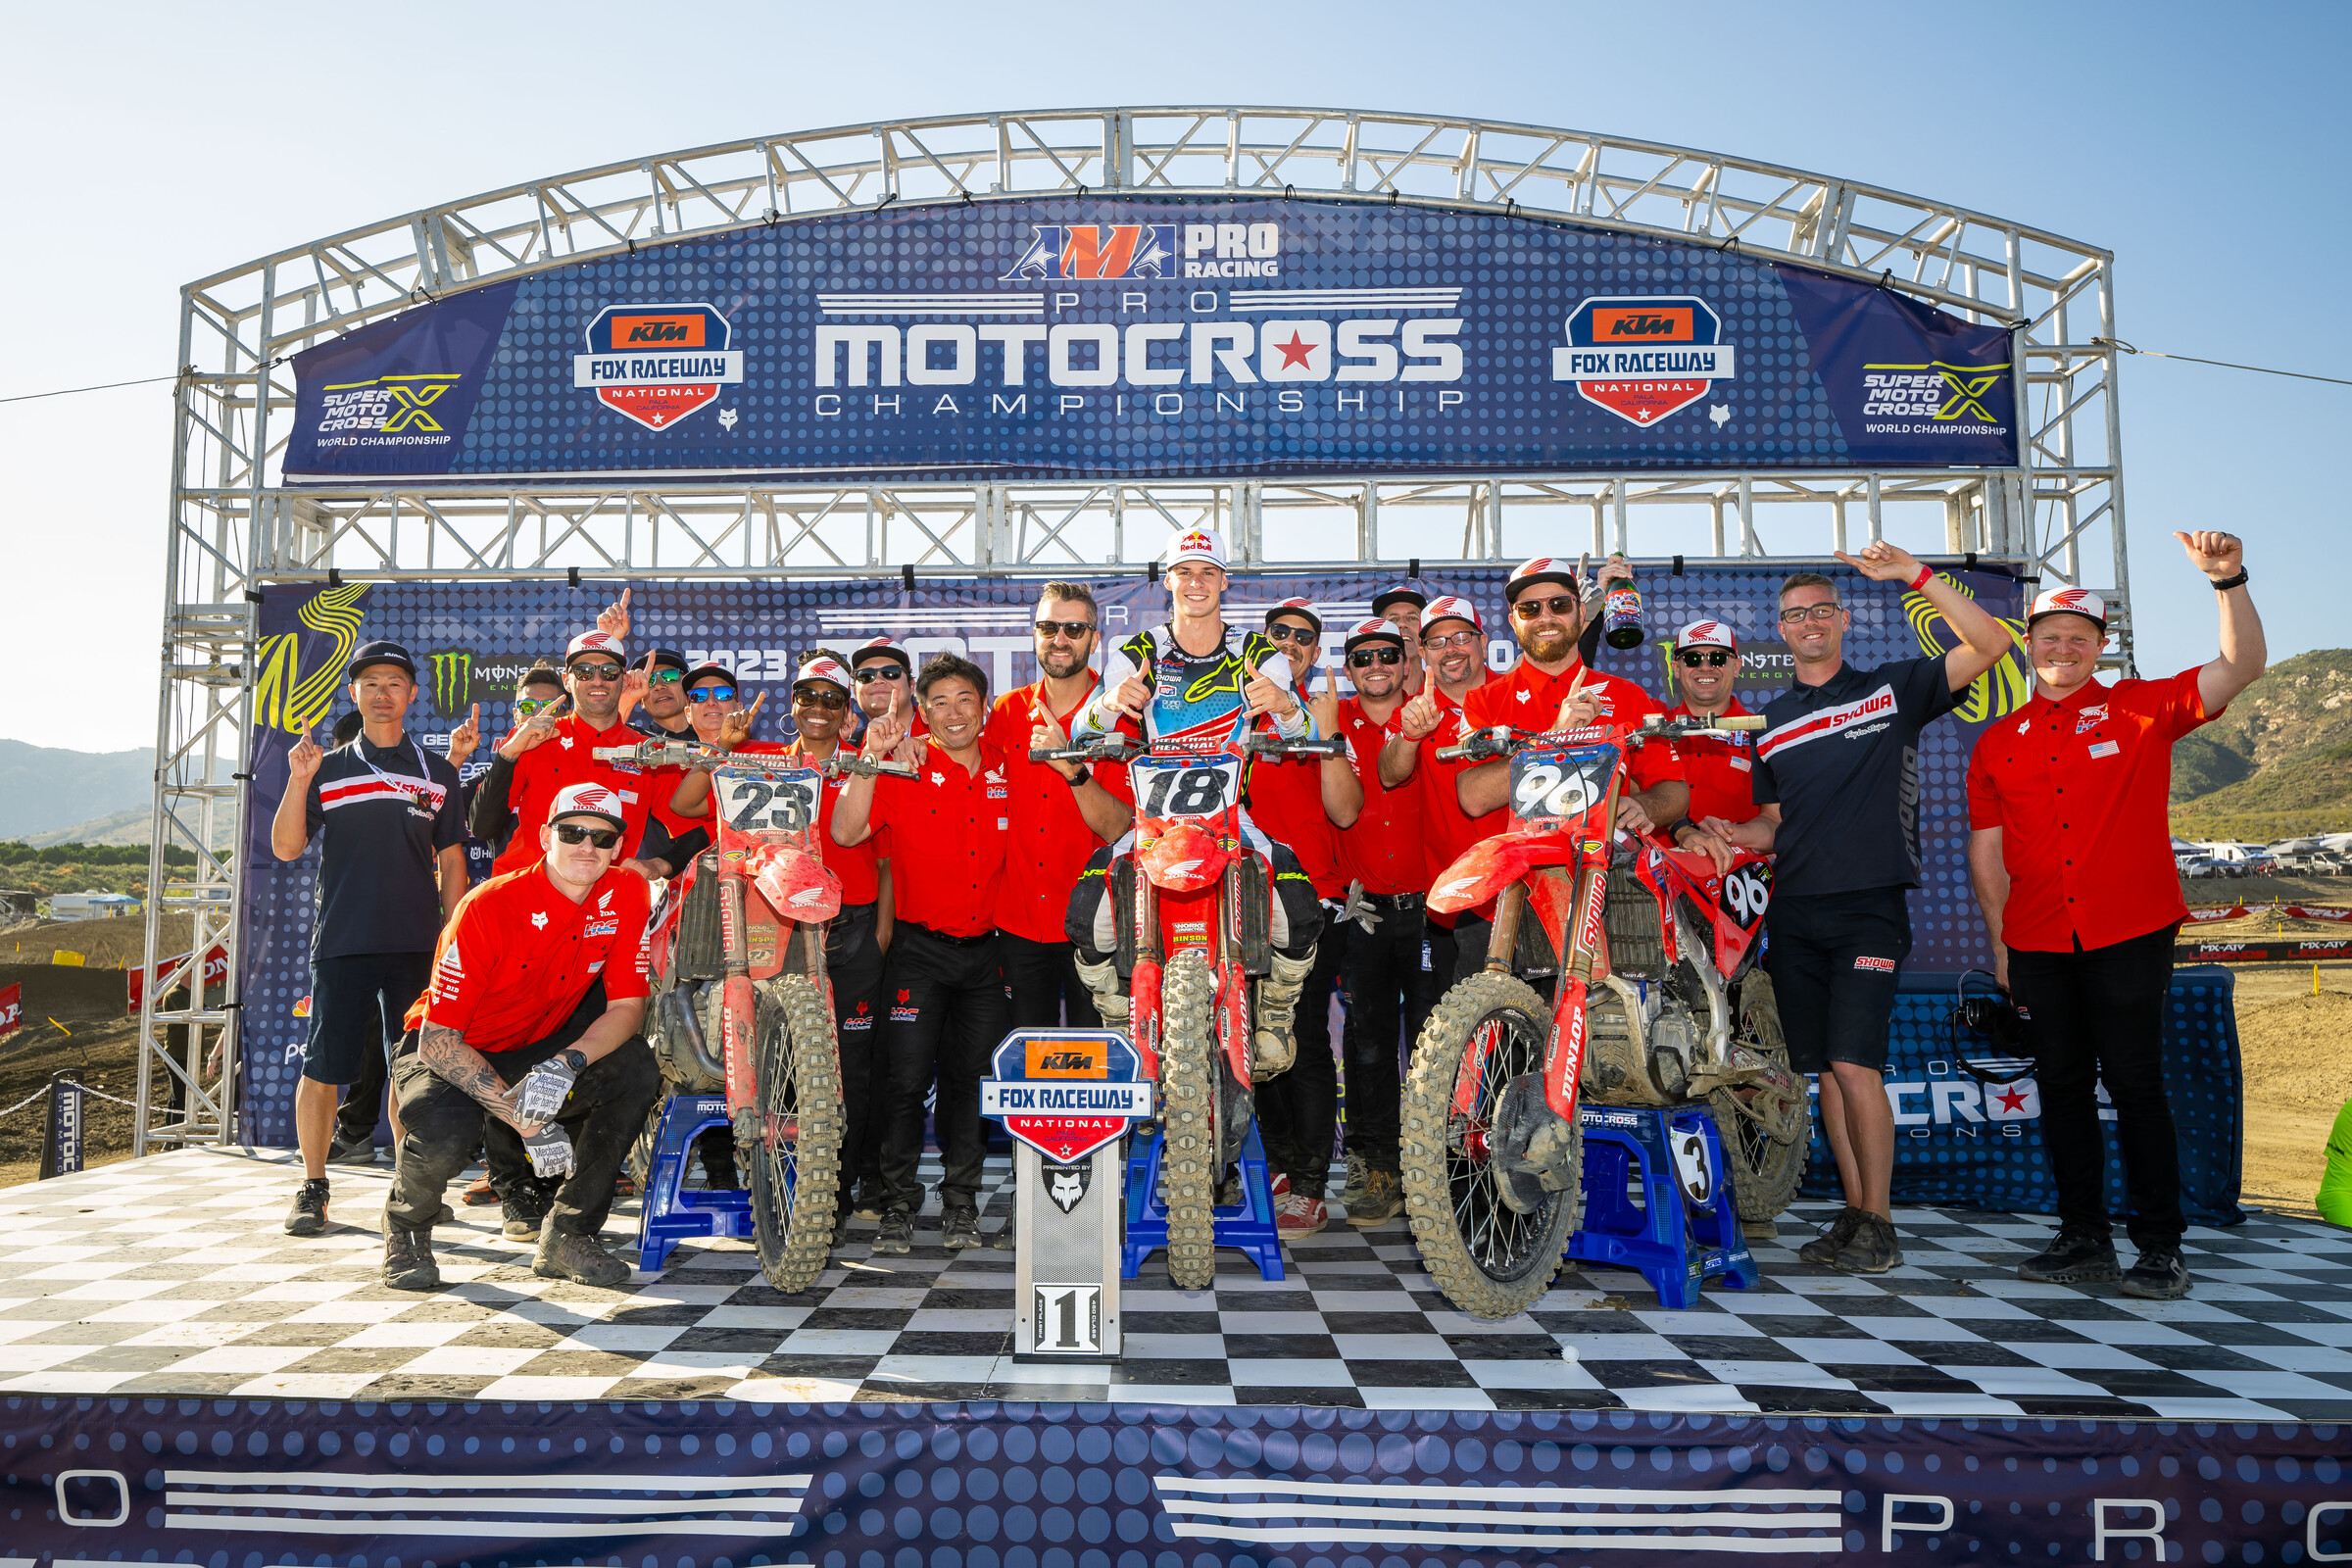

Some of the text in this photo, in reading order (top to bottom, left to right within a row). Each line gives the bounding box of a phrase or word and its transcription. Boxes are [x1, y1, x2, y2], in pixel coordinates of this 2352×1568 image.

[1184, 222, 1278, 260] PRO
[998, 224, 1177, 280] AMA
[1184, 260, 1278, 278] RACING
[1055, 290, 1219, 316] PRO
[627, 321, 688, 342] KTM
[1610, 315, 1675, 335] KTM
[814, 318, 1464, 387] MOTOCROSS
[591, 358, 726, 380] FOX RACEWAY
[1571, 352, 1716, 373] FOX RACEWAY
[1594, 383, 1694, 393] NATIONAL
[1863, 374, 1945, 388] SUPER
[321, 389, 393, 408] SUPER
[612, 388, 706, 398] NATIONAL
[1868, 388, 1940, 403] MOTO
[324, 403, 388, 419] MOTO
[814, 389, 1465, 416] CHAMPIONSHIP
[1863, 402, 1941, 416] CROSS
[318, 416, 389, 432] CROSS
[1865, 423, 2007, 435] WORLD CHAMPIONSHIP
[317, 435, 451, 447] WORLD CHAMPIONSHIP
[1180, 542, 1212, 552] Red Bull
[1431, 611, 1462, 620] HONDA
[2049, 604, 2090, 614] HONDA
[1689, 636, 1721, 645] HONDA
[1740, 651, 1795, 669] NSTE
[808, 671, 840, 684] HONDA
[1154, 674, 1183, 683] SHOWA
[1832, 694, 1892, 728] SHOWA
[1154, 742, 1216, 752] RENTHAL
[1144, 768, 1230, 819] 18
[1514, 764, 1600, 821] 96
[572, 804, 611, 815] HONDA
[728, 781, 814, 832] 23
[1435, 892, 1475, 901] HONDA
[1725, 866, 1769, 929] 96
[1584, 872, 1607, 948] SHOWA
[583, 919, 619, 938] HRC
[1854, 956, 1896, 970] SHOWA
[2188, 950, 2268, 961] LEGENDS
[1239, 989, 1250, 1076] DUNLOP
[724, 1006, 736, 1091] DUNLOP
[1562, 1005, 1585, 1103] DUNLOP
[1039, 1052, 1094, 1070] KTM
[526, 1081, 558, 1099] Mechanix
[535, 1073, 567, 1090] Mechanix
[999, 1088, 1134, 1109] FOX RACEWAY
[1020, 1119, 1113, 1128] NATIONAL
[1581, 1113, 1638, 1125] OTOCROSS
[534, 1145, 567, 1157] Mechanix
[1683, 1136, 1707, 1200] 3
[1054, 1290, 1080, 1348] 1
